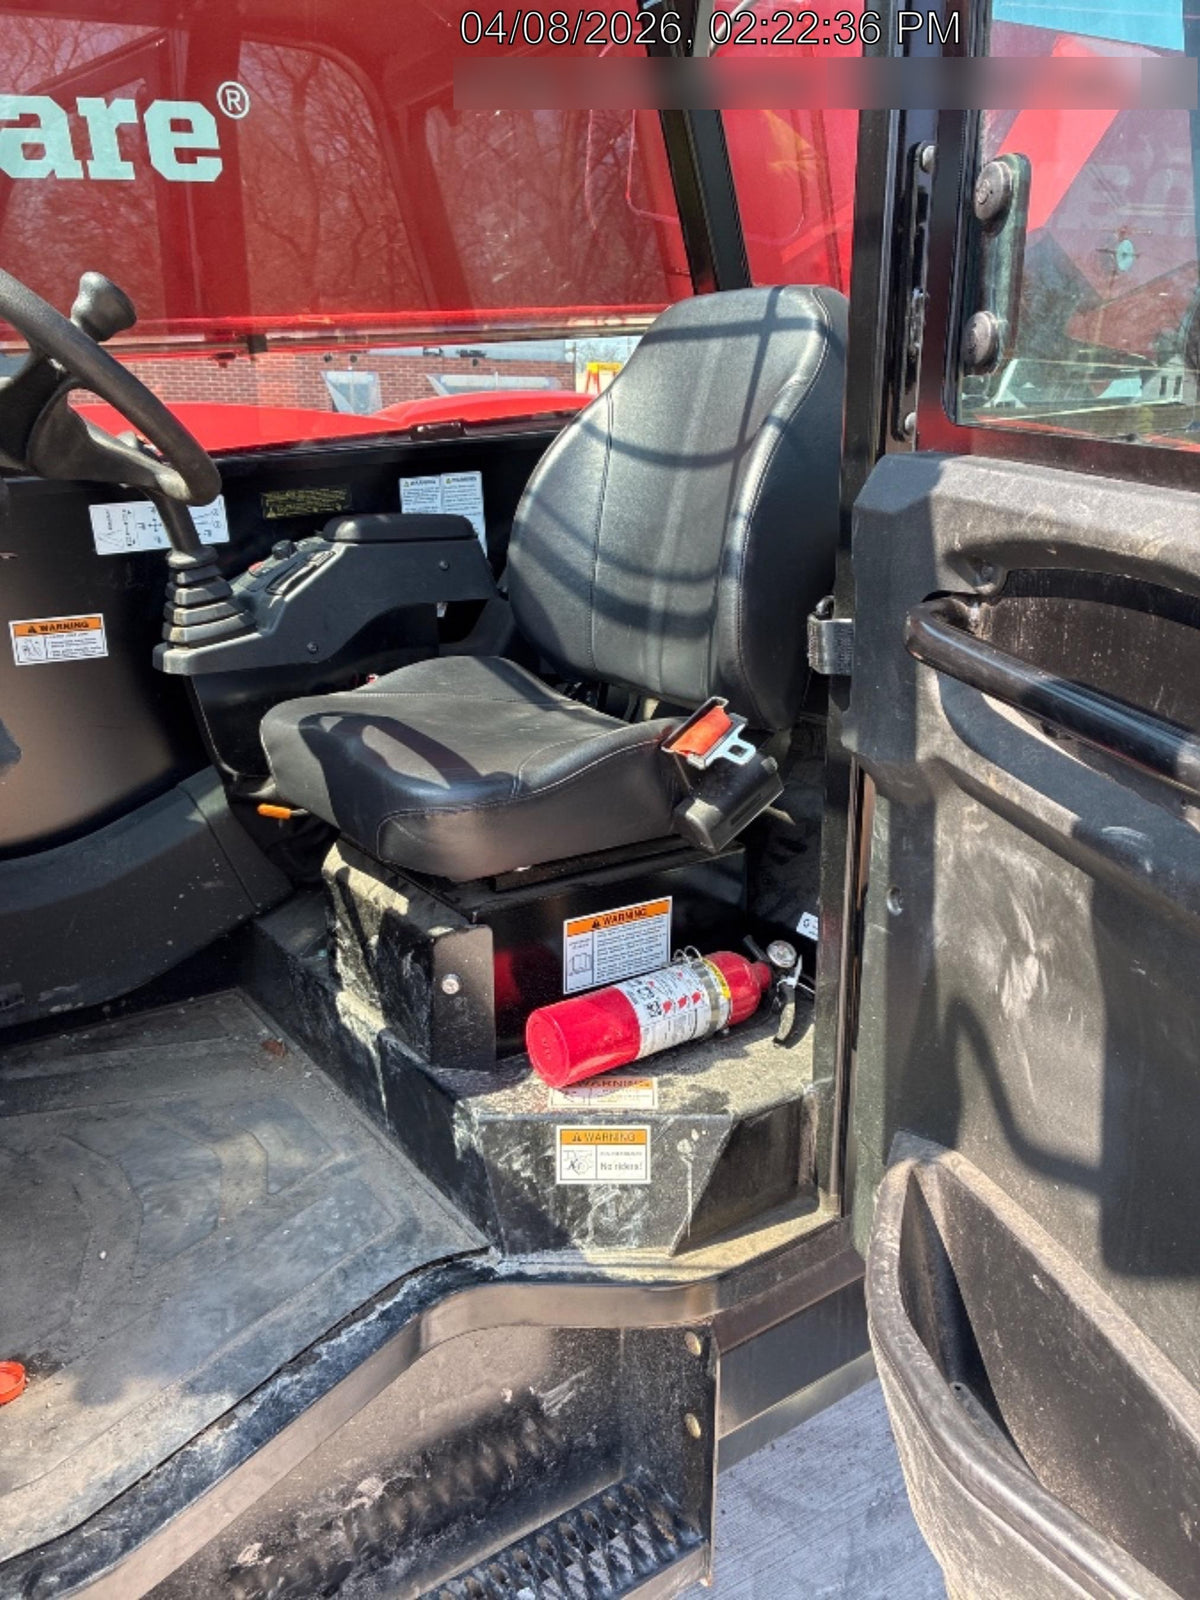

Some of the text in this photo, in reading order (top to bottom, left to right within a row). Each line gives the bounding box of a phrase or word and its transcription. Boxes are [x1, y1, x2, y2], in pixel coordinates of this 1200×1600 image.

[38, 620, 90, 632] WARNING
[602, 907, 648, 926] WARNING
[584, 1132, 636, 1142] WARNING
[600, 1162, 613, 1171] No
